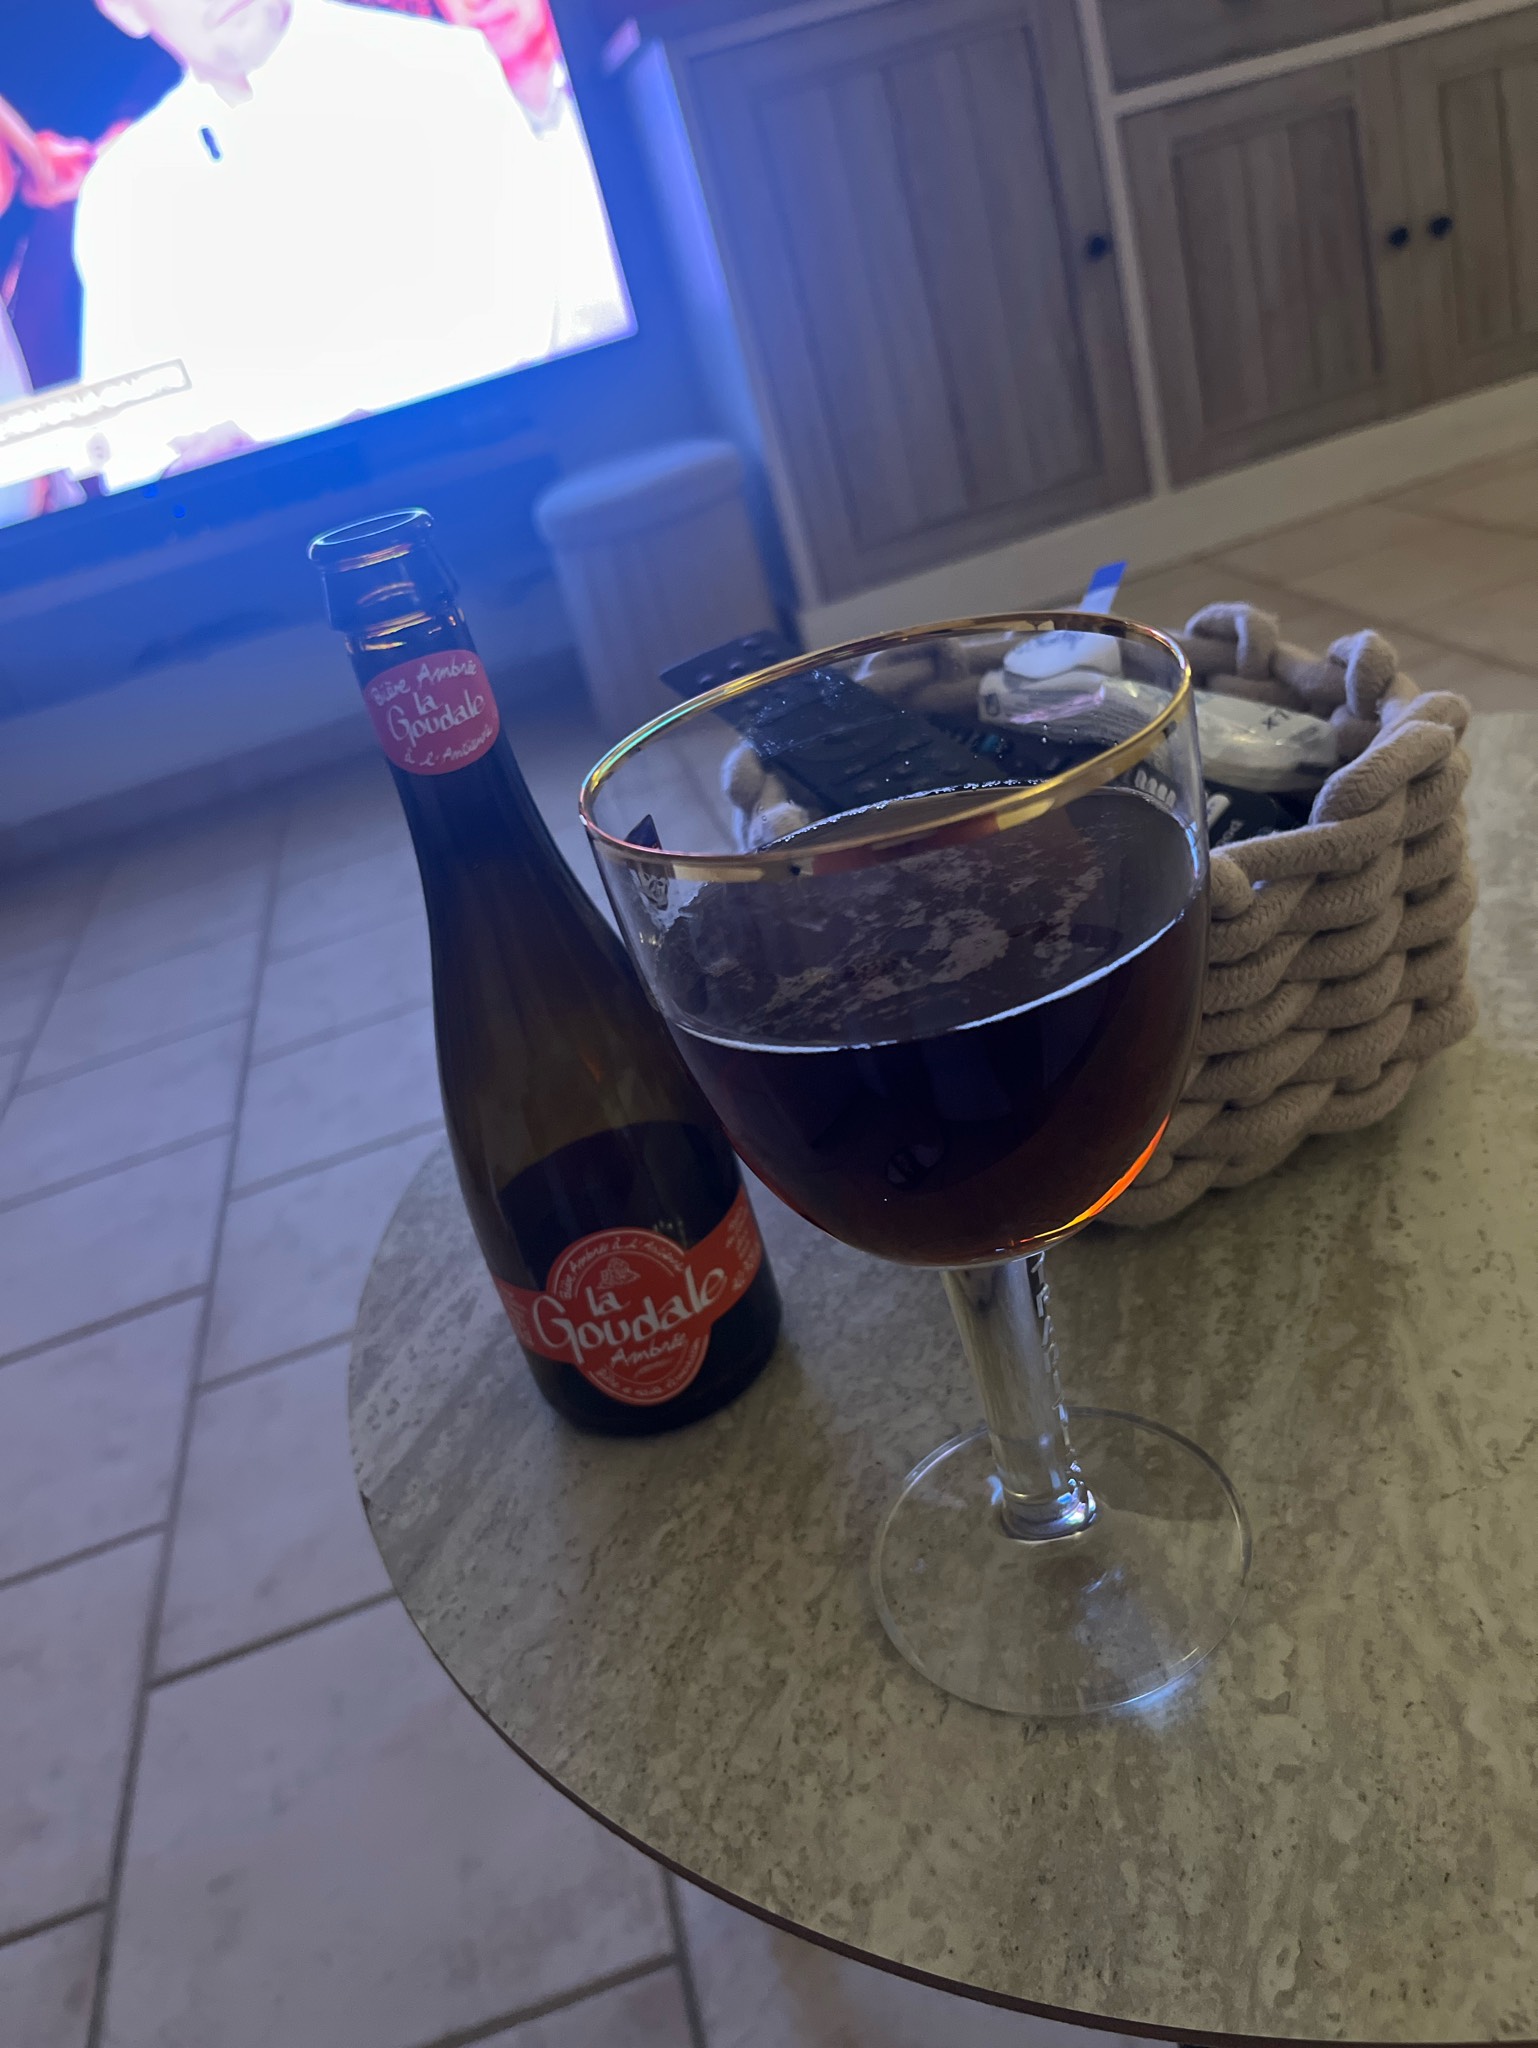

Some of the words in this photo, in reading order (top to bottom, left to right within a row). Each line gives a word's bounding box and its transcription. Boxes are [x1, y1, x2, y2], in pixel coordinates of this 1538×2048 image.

[387, 690, 486, 747] Goudale
[413, 692, 443, 716] la
[532, 1265, 728, 1365] Goudale
[586, 1286, 630, 1317] la
